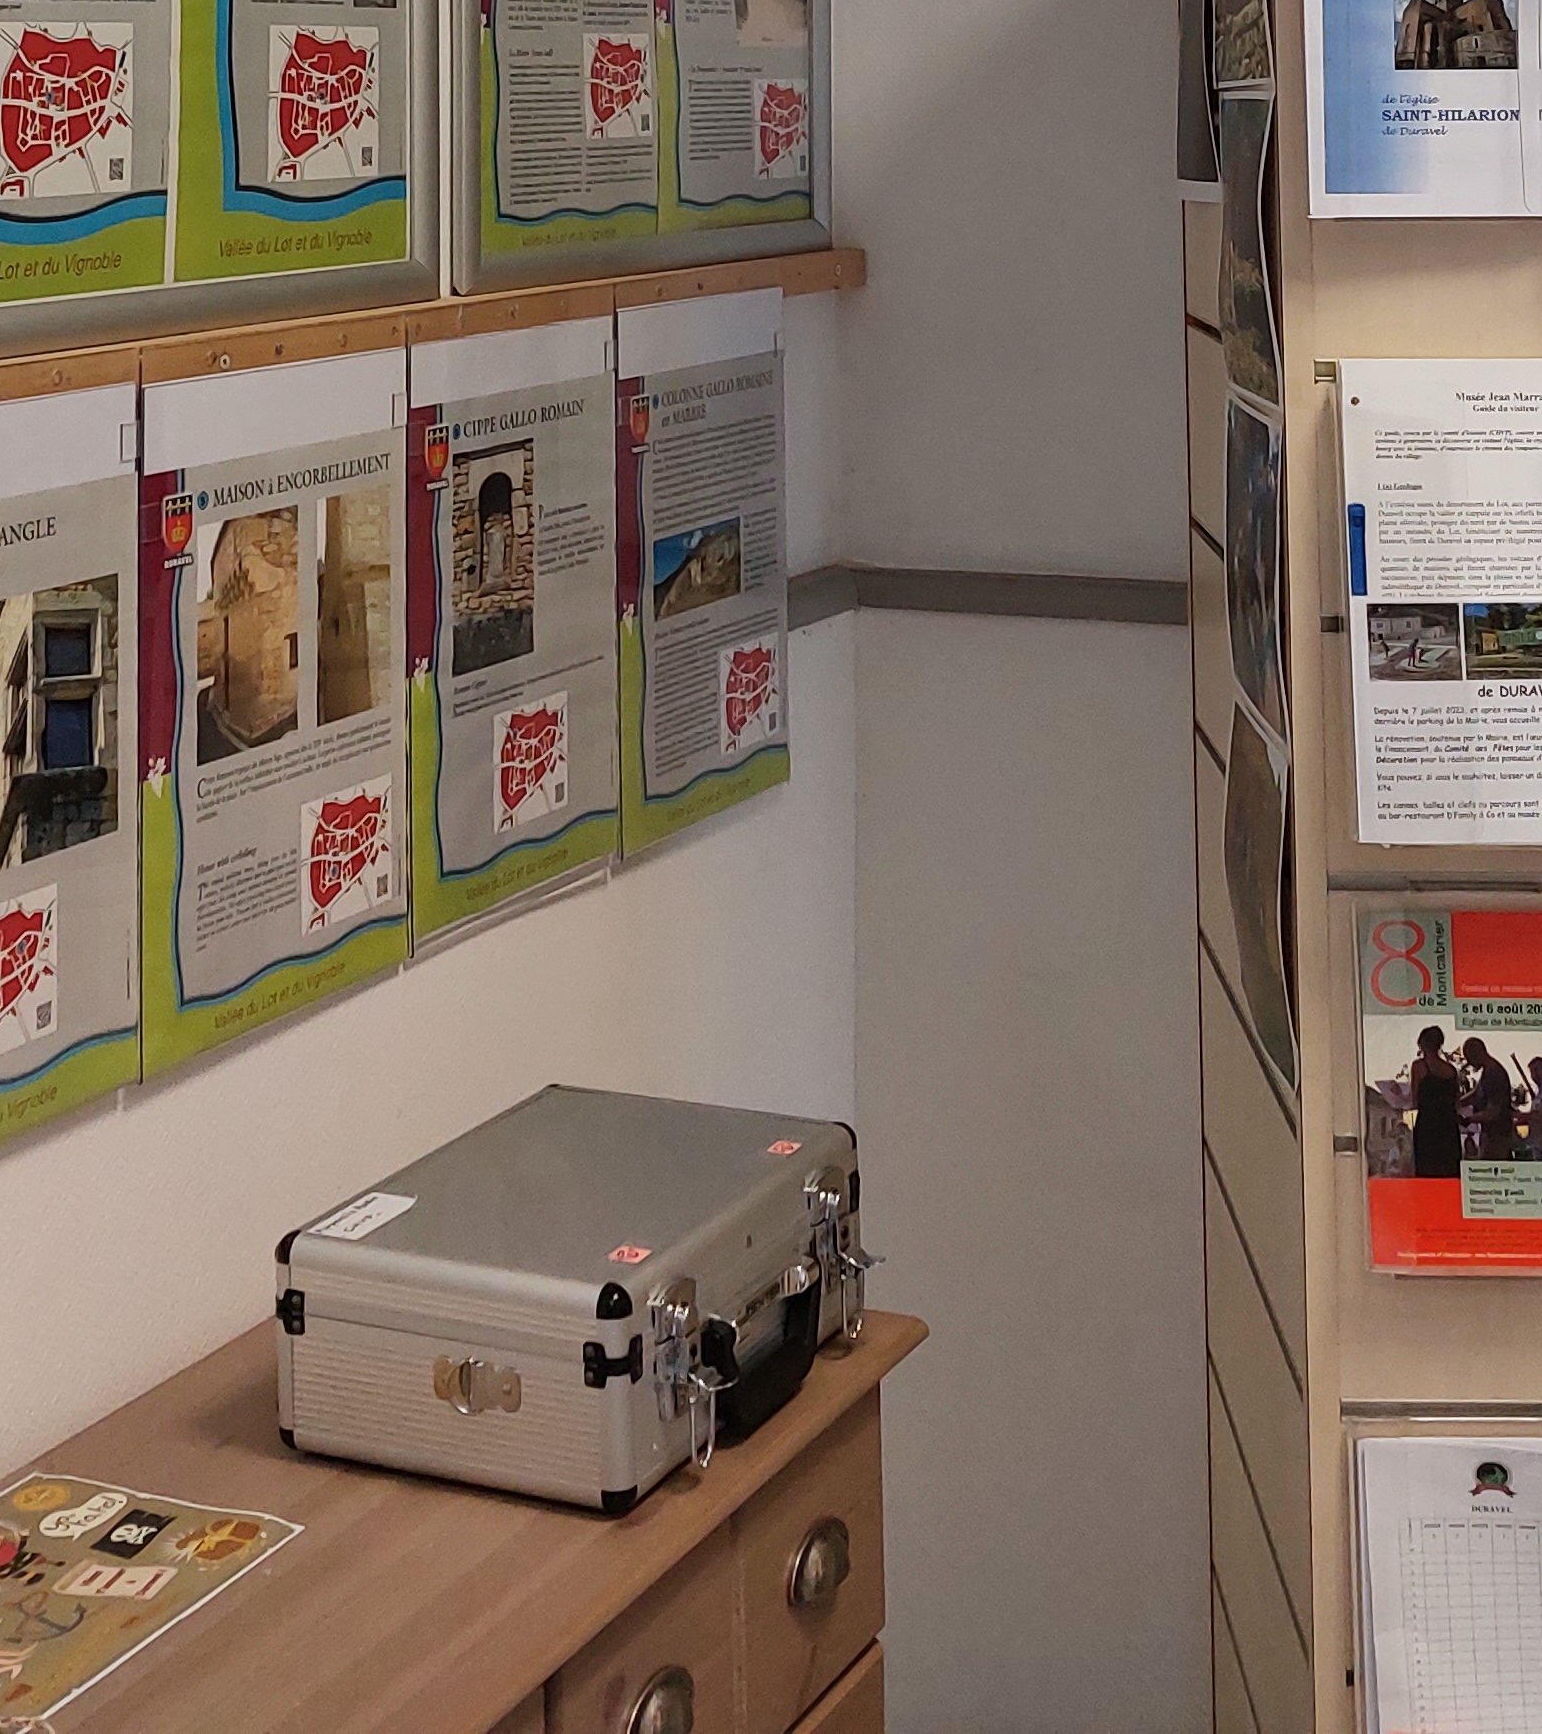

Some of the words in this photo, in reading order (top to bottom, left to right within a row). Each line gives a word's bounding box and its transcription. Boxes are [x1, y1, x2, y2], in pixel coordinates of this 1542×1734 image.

[1382, 95, 1398, 104] de
[1381, 109, 1520, 122] SAINT-HILARION
[1382, 126, 1397, 135] de
[1400, 126, 1449, 136] Duravel
[1456, 392, 1485, 401] Musée
[1489, 392, 1510, 401] Jean
[463, 417, 498, 438] CIPPE
[499, 409, 538, 433] GALLO
[540, 399, 586, 423] ROMAIN
[213, 480, 265, 508] MAISON
[277, 453, 391, 492] ENCORBELLEMENT
[1478, 685, 1494, 697] de
[1371, 919, 1431, 1008] 8
[1418, 995, 1435, 1007] de
[1434, 919, 1448, 1007] Montcabrier
[1472, 1004, 1483, 1014] et
[1486, 1004, 1494, 1014] 6
[1497, 1003, 1524, 1014] août
[1472, 1505, 1513, 1513] DURAVEL
